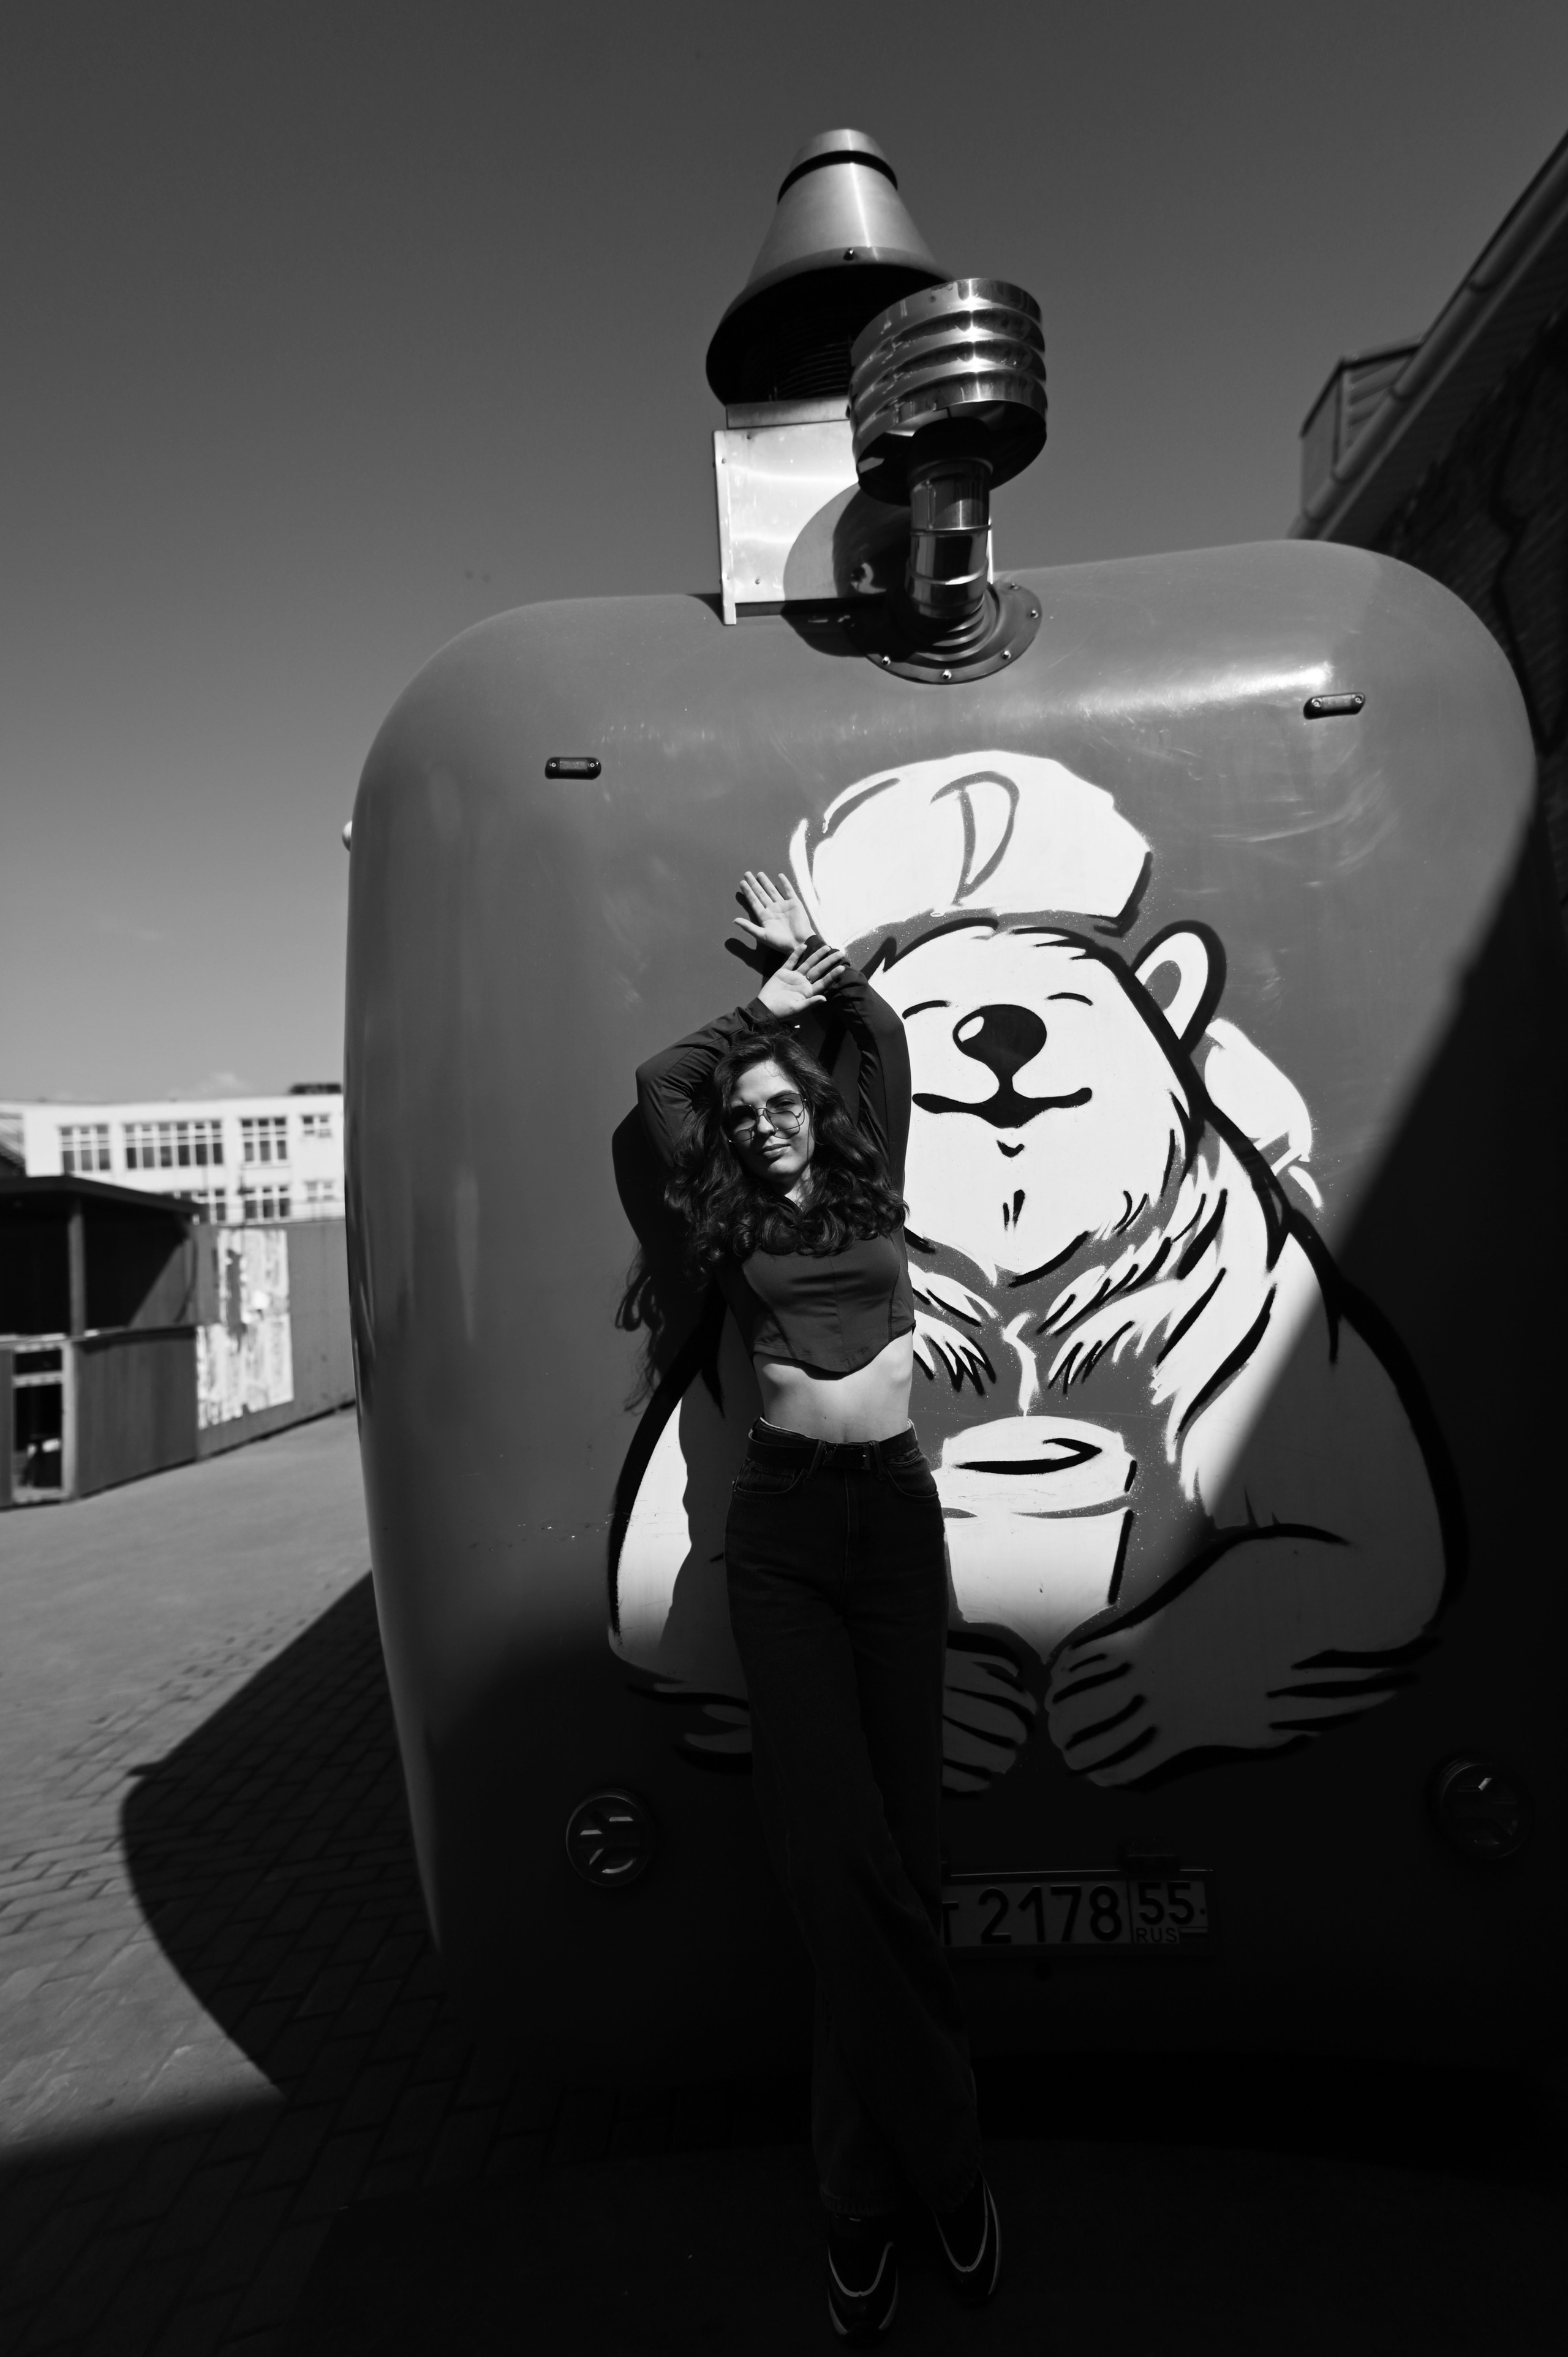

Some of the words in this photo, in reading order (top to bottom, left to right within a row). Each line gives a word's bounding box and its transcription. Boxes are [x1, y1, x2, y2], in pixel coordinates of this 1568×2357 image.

[978, 1885, 1122, 1944] 2178
[1138, 1882, 1194, 1925] 55
[1136, 1928, 1177, 1942] RUS
